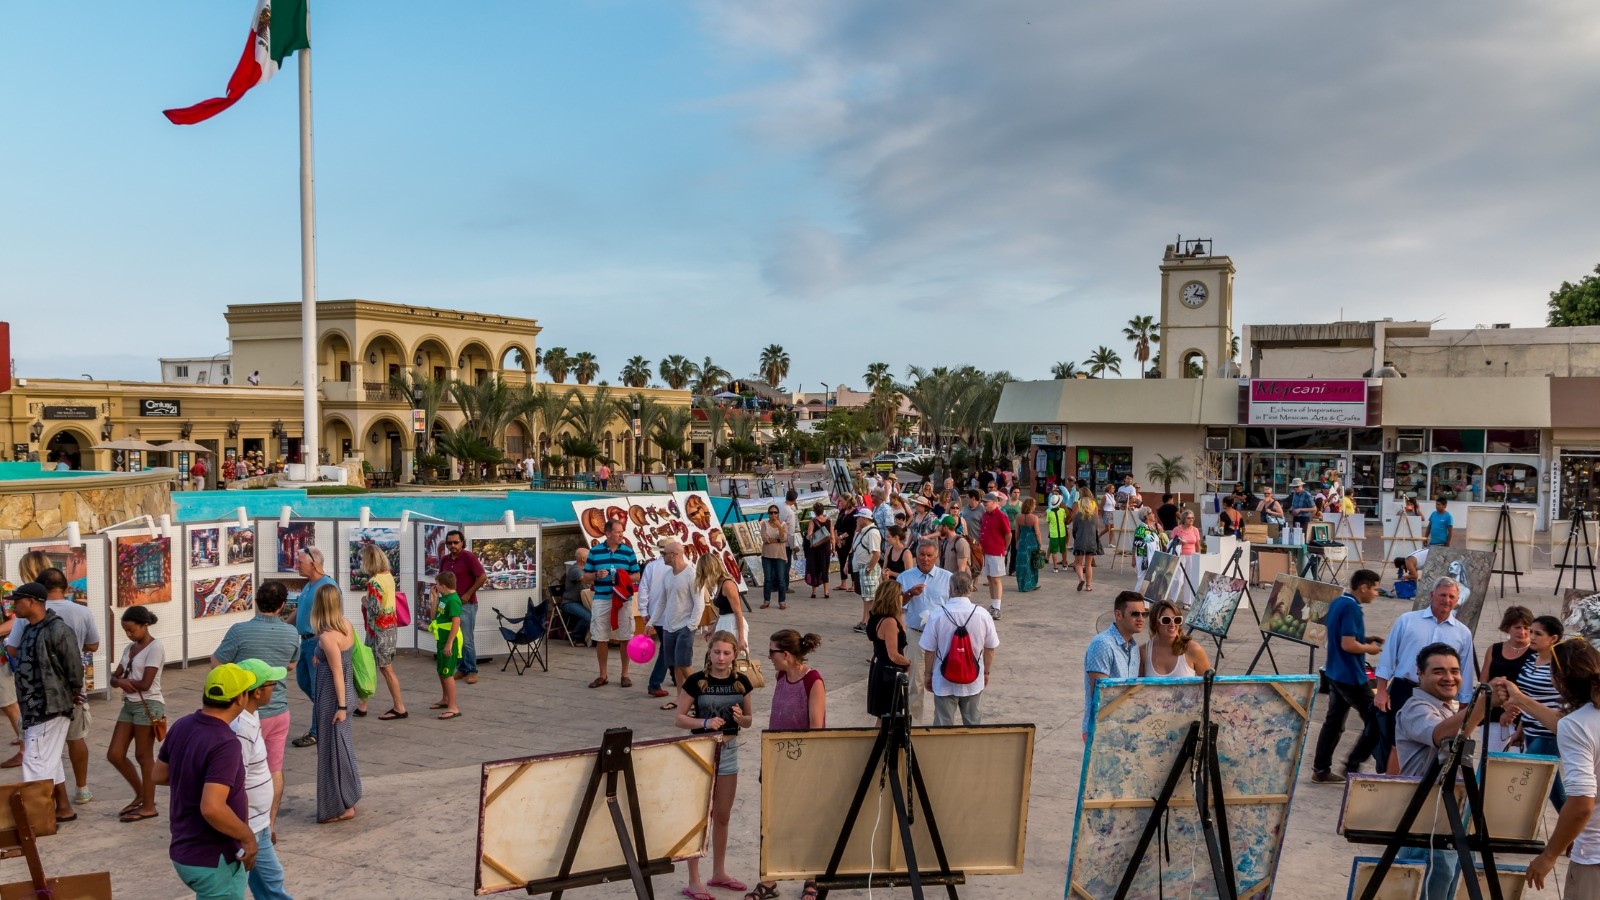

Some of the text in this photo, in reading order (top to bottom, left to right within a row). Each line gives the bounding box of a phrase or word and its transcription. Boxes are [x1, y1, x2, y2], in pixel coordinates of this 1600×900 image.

[145, 400, 178, 414] Century 21
[1307, 406, 1343, 415] Inspiration
[1336, 414, 1361, 422] Crafts
